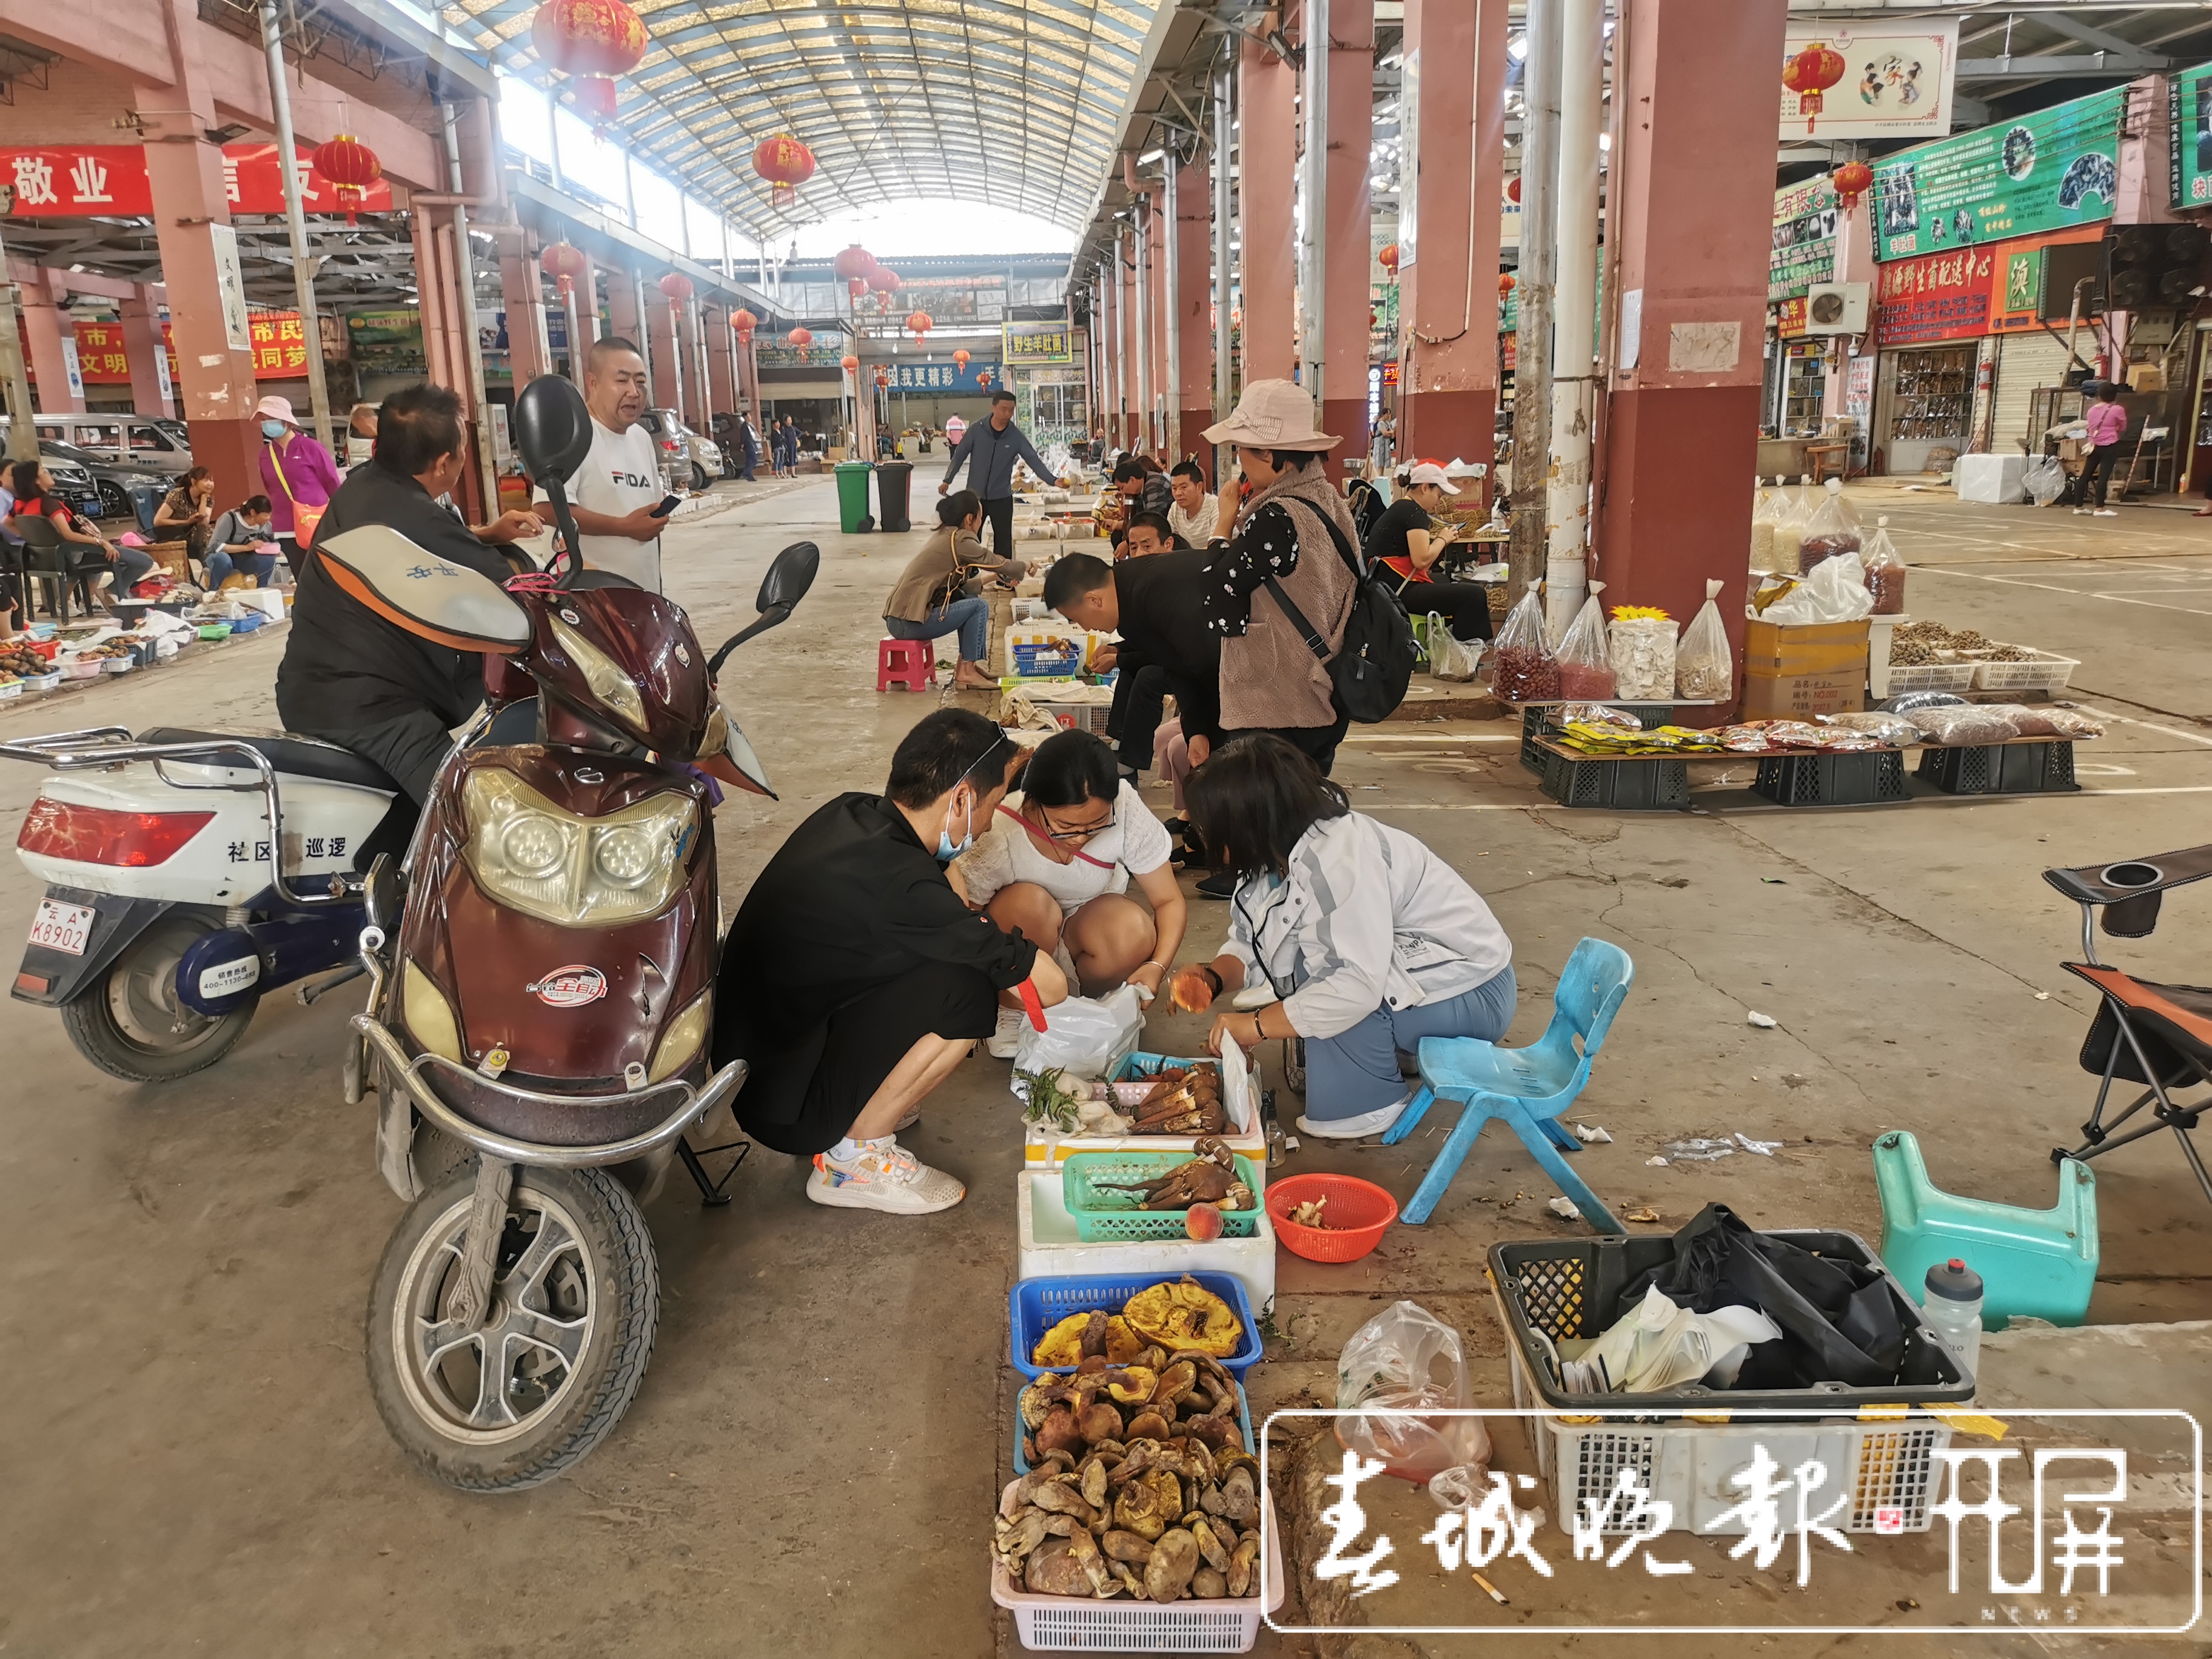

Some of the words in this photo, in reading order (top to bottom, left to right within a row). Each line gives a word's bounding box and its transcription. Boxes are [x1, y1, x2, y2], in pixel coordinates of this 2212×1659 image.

[12, 156, 113, 205] 敬业
[2191, 175, 2212, 199] 块
[1890, 233, 1916, 255] 羊肚菌
[228, 841, 271, 863] 社区
[306, 837, 346, 858] 巡逻
[32, 920, 82, 950] K8902
